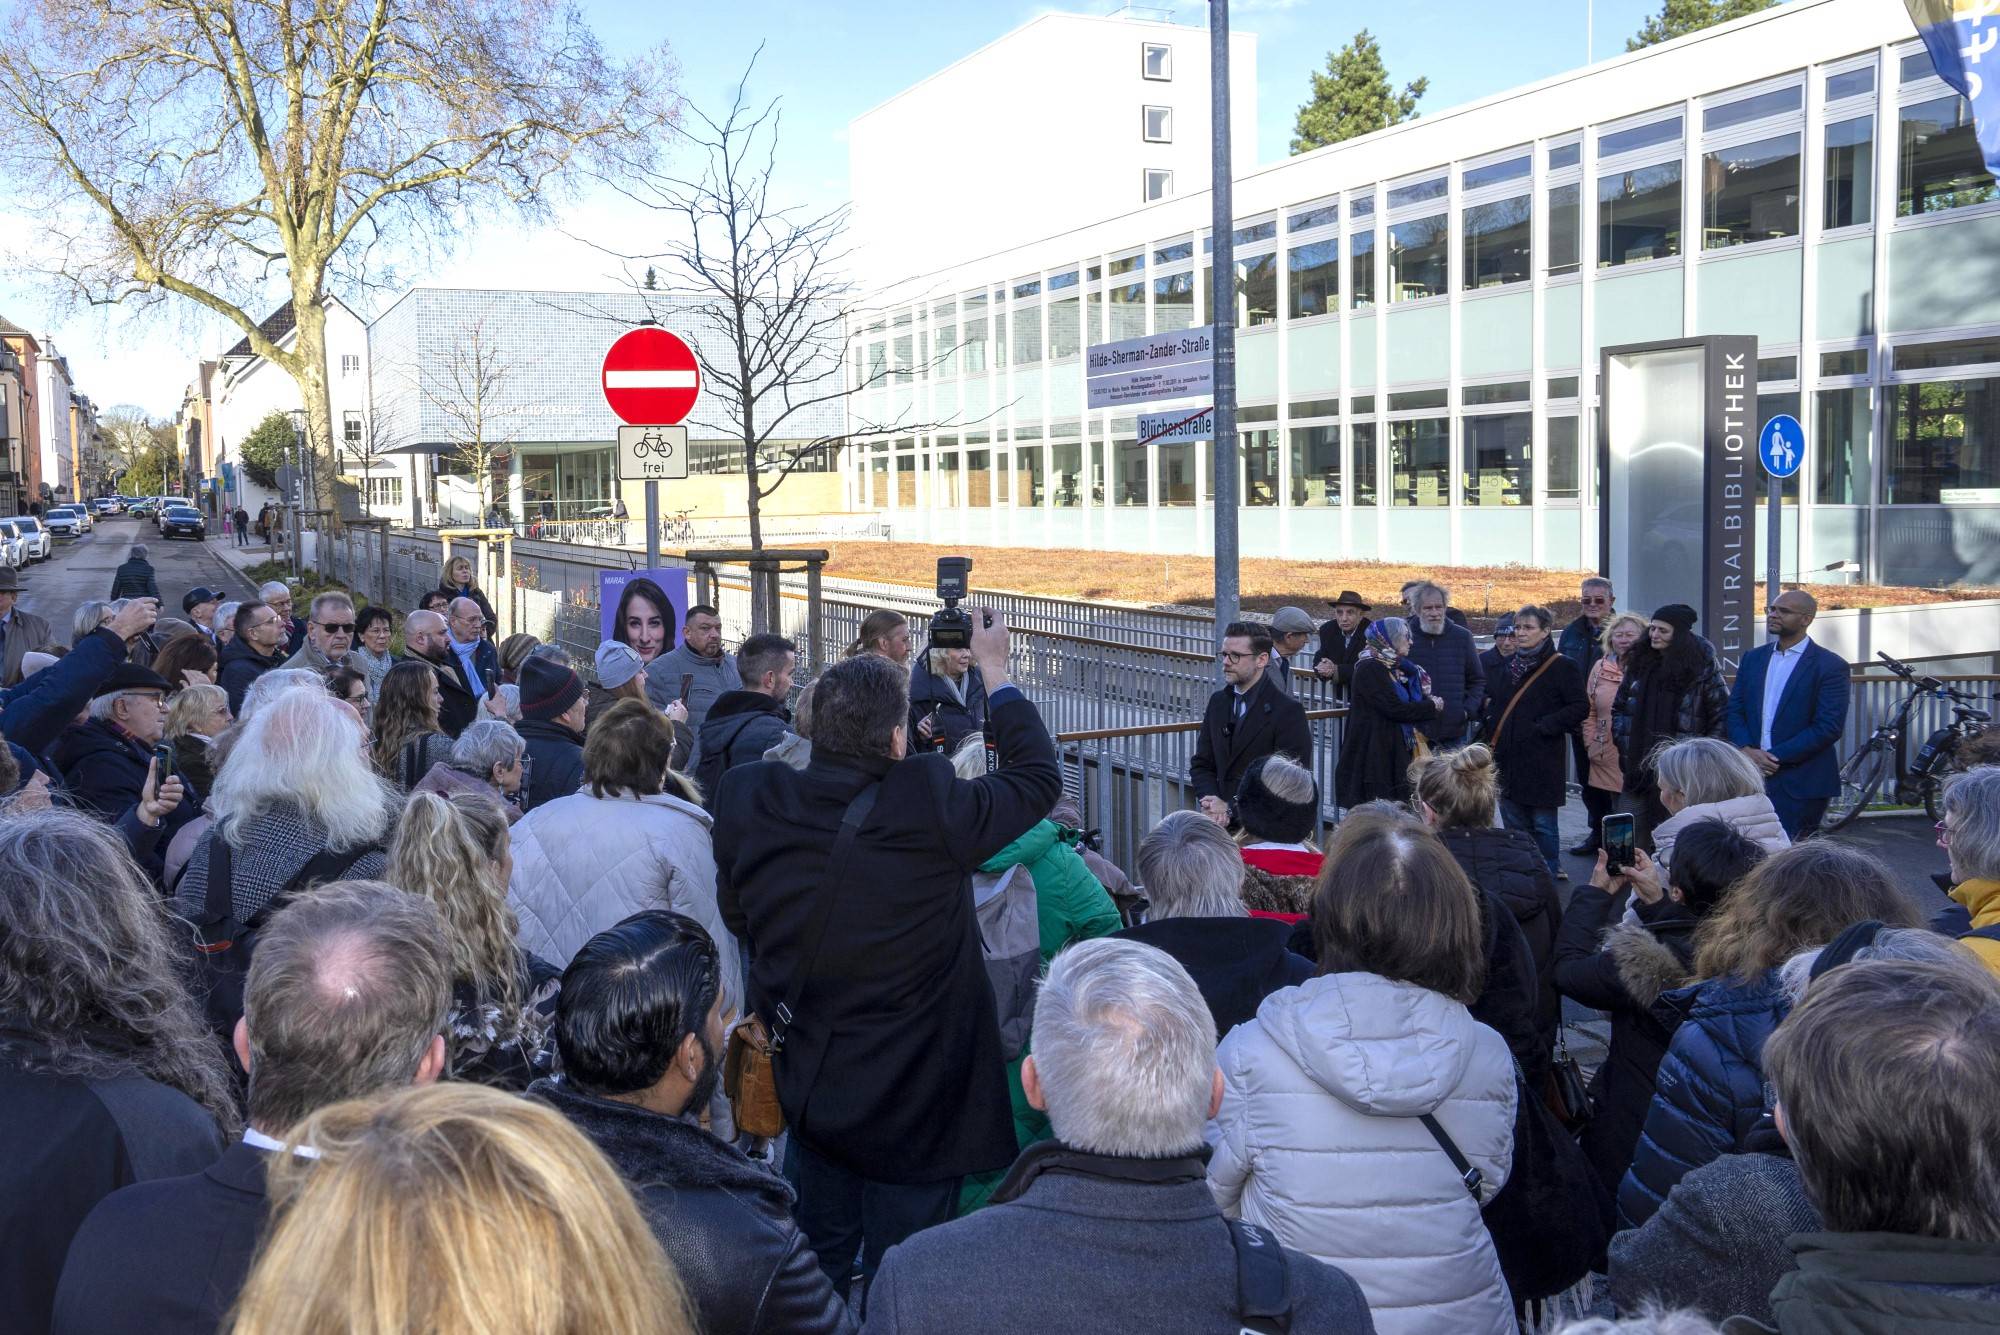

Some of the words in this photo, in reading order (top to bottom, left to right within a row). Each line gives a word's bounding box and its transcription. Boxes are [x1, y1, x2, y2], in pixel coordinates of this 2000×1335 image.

[1089, 335, 1210, 369] Hilde-Sherman-Zander-Straße
[1140, 415, 1212, 439] Blücherstraße
[643, 461, 665, 473] frei
[1721, 352, 1745, 671] ZENTRALBIBLIOTHEK
[987, 750, 995, 772] RX10
